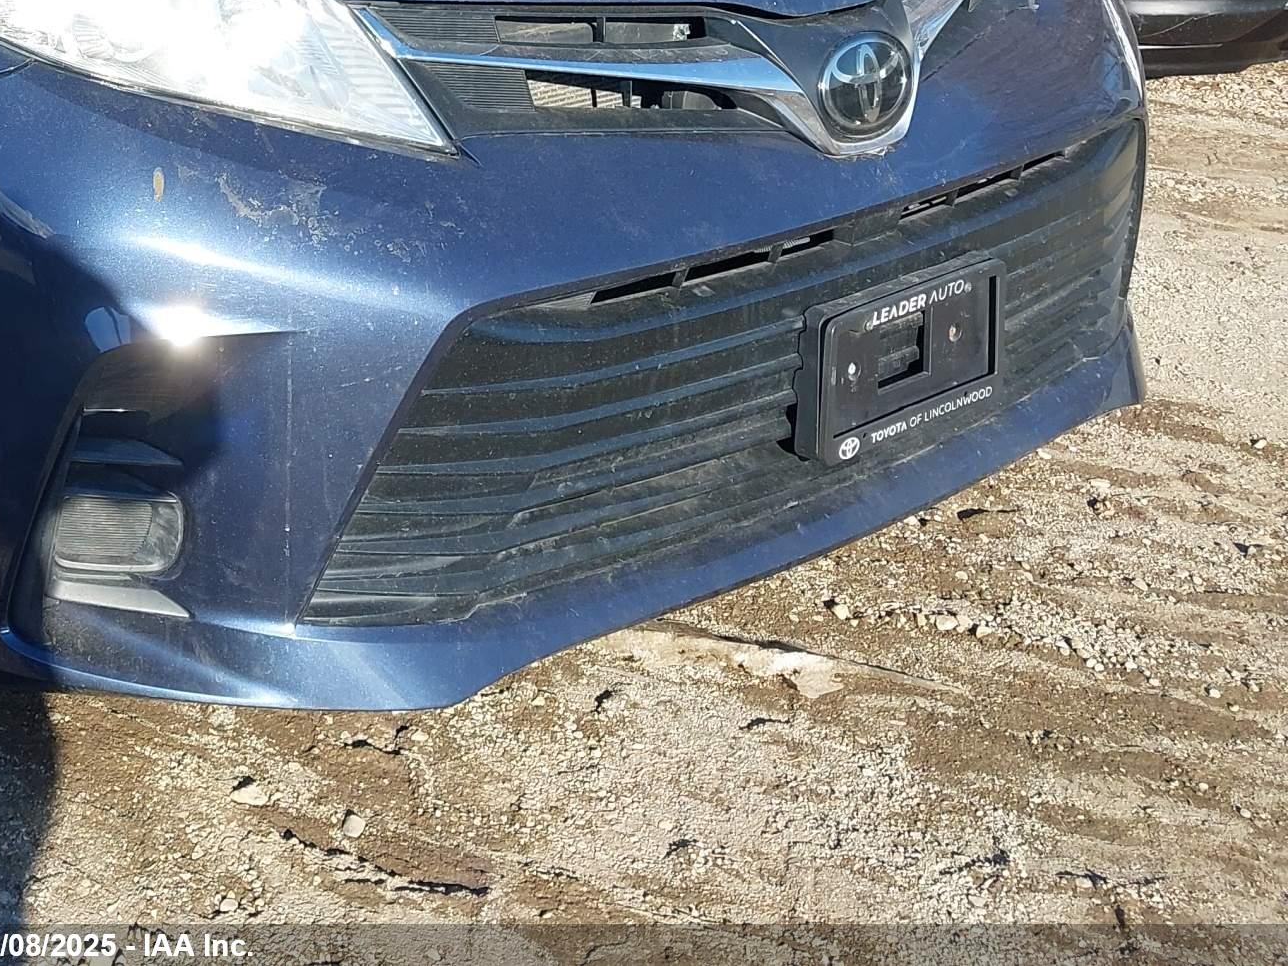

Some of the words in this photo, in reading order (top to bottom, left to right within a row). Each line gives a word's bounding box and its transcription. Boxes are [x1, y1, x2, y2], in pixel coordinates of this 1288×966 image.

[871, 293, 927, 327] LEADER
[929, 279, 964, 305] AUTO
[870, 422, 908, 444] TOYOTA
[909, 413, 923, 429] OF
[924, 386, 993, 422] LINCOLNWOOD
